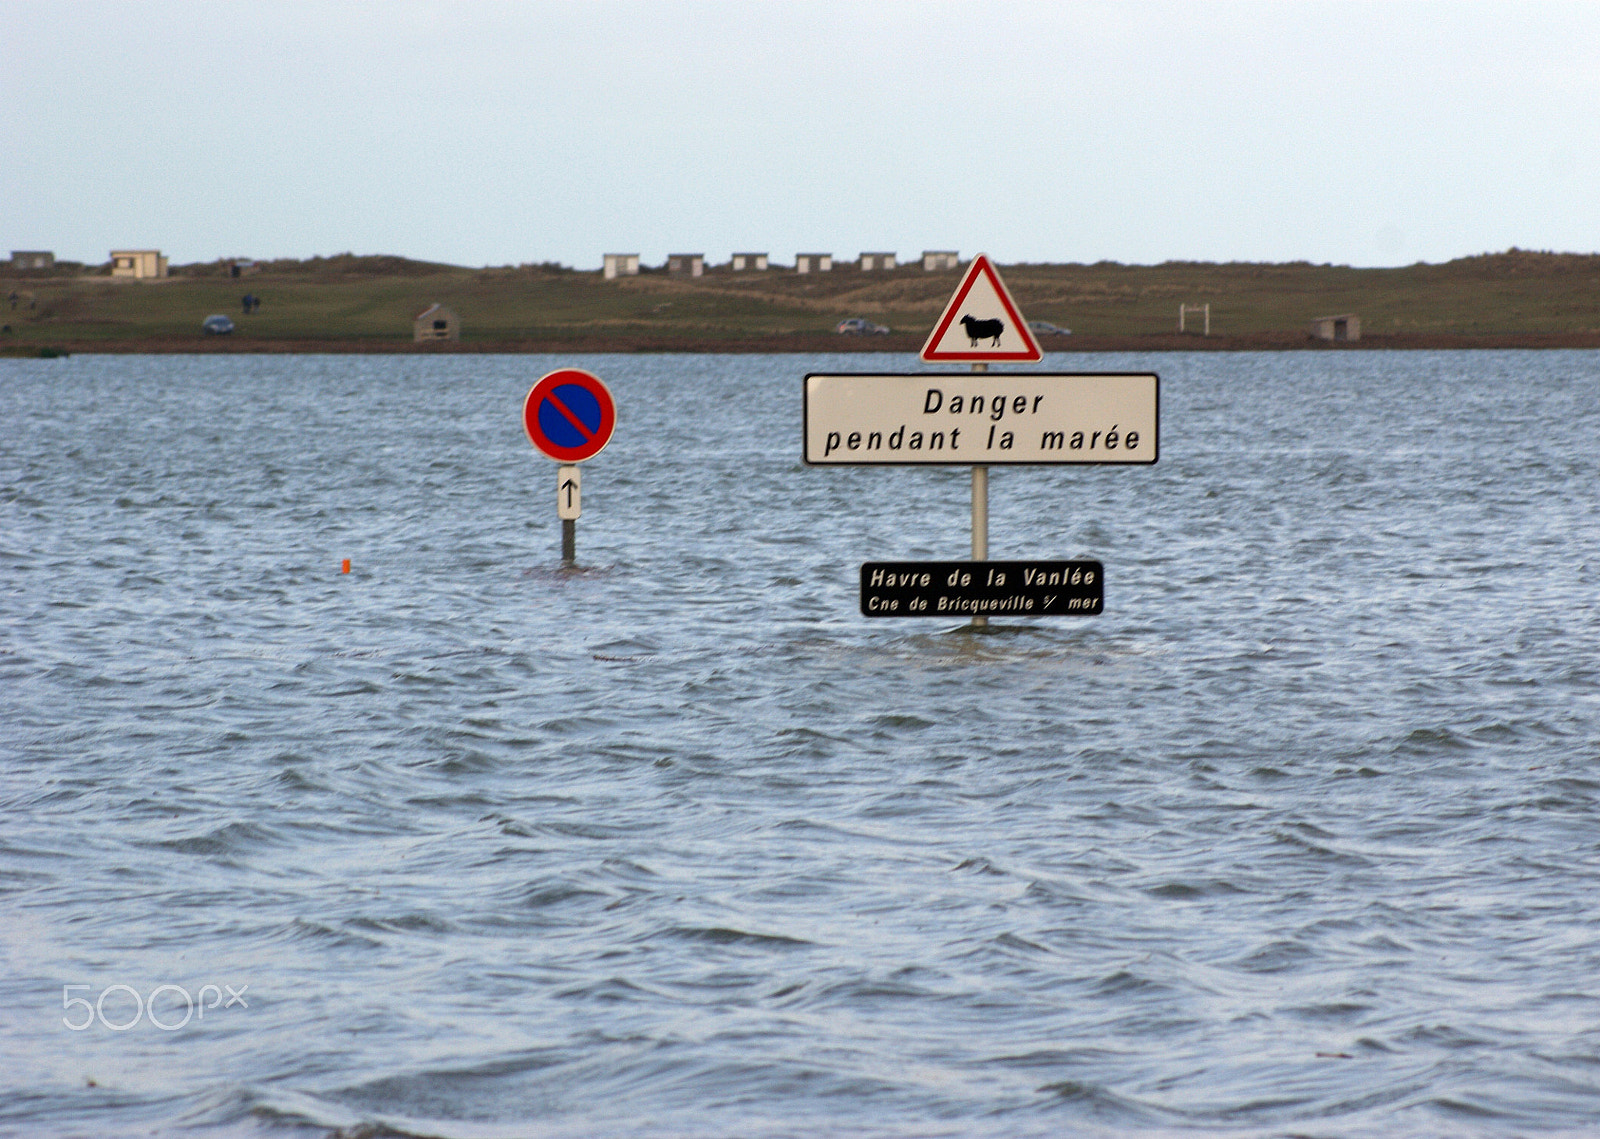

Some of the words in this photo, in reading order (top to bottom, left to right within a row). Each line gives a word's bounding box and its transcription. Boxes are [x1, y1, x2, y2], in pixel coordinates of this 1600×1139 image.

[923, 389, 1044, 421] Danger
[824, 425, 961, 457] pendant
[986, 425, 1015, 450] la
[1040, 424, 1141, 450] marée
[869, 568, 932, 587] Havre
[947, 568, 972, 587] de
[986, 568, 1007, 587] la
[1023, 566, 1096, 587] Vanlée
[868, 596, 900, 611] Cne
[908, 596, 928, 611] de
[937, 595, 1035, 614] Bricqueville
[1067, 598, 1100, 611] mer
